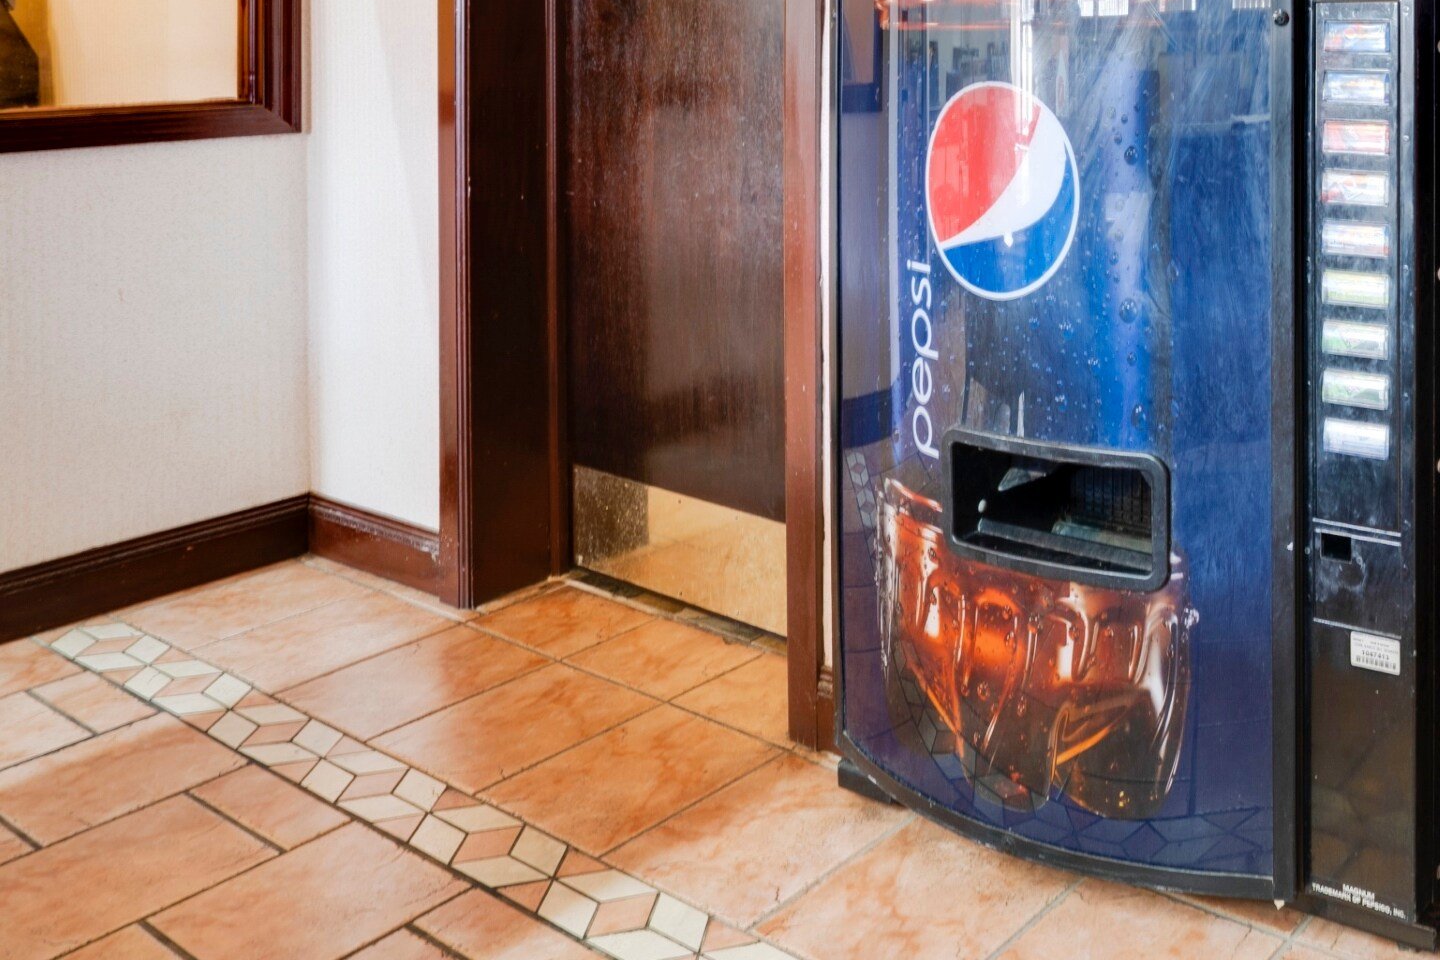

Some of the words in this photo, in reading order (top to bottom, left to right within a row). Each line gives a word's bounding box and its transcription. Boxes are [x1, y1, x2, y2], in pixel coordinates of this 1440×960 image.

[906, 260, 939, 460] pepsi
[1311, 882, 1351, 902] TRADEMARK
[1352, 894, 1362, 904] OF
